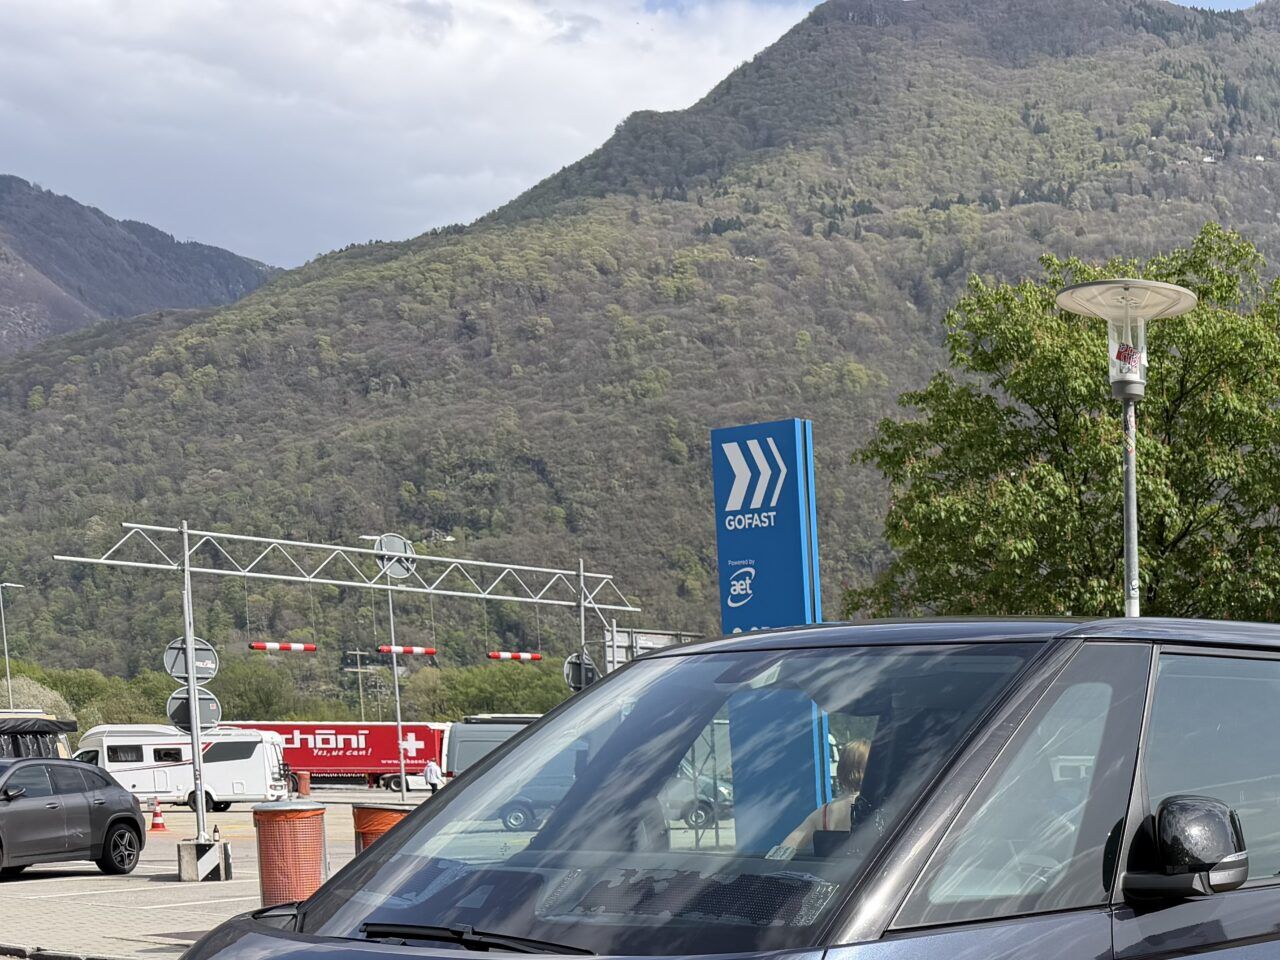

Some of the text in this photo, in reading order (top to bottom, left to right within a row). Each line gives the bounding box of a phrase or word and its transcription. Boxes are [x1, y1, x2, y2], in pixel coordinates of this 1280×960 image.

[725, 511, 776, 530] GOFAST
[730, 576, 753, 595] aet
[280, 730, 369, 749] chöni
[313, 748, 330, 757] Yes,
